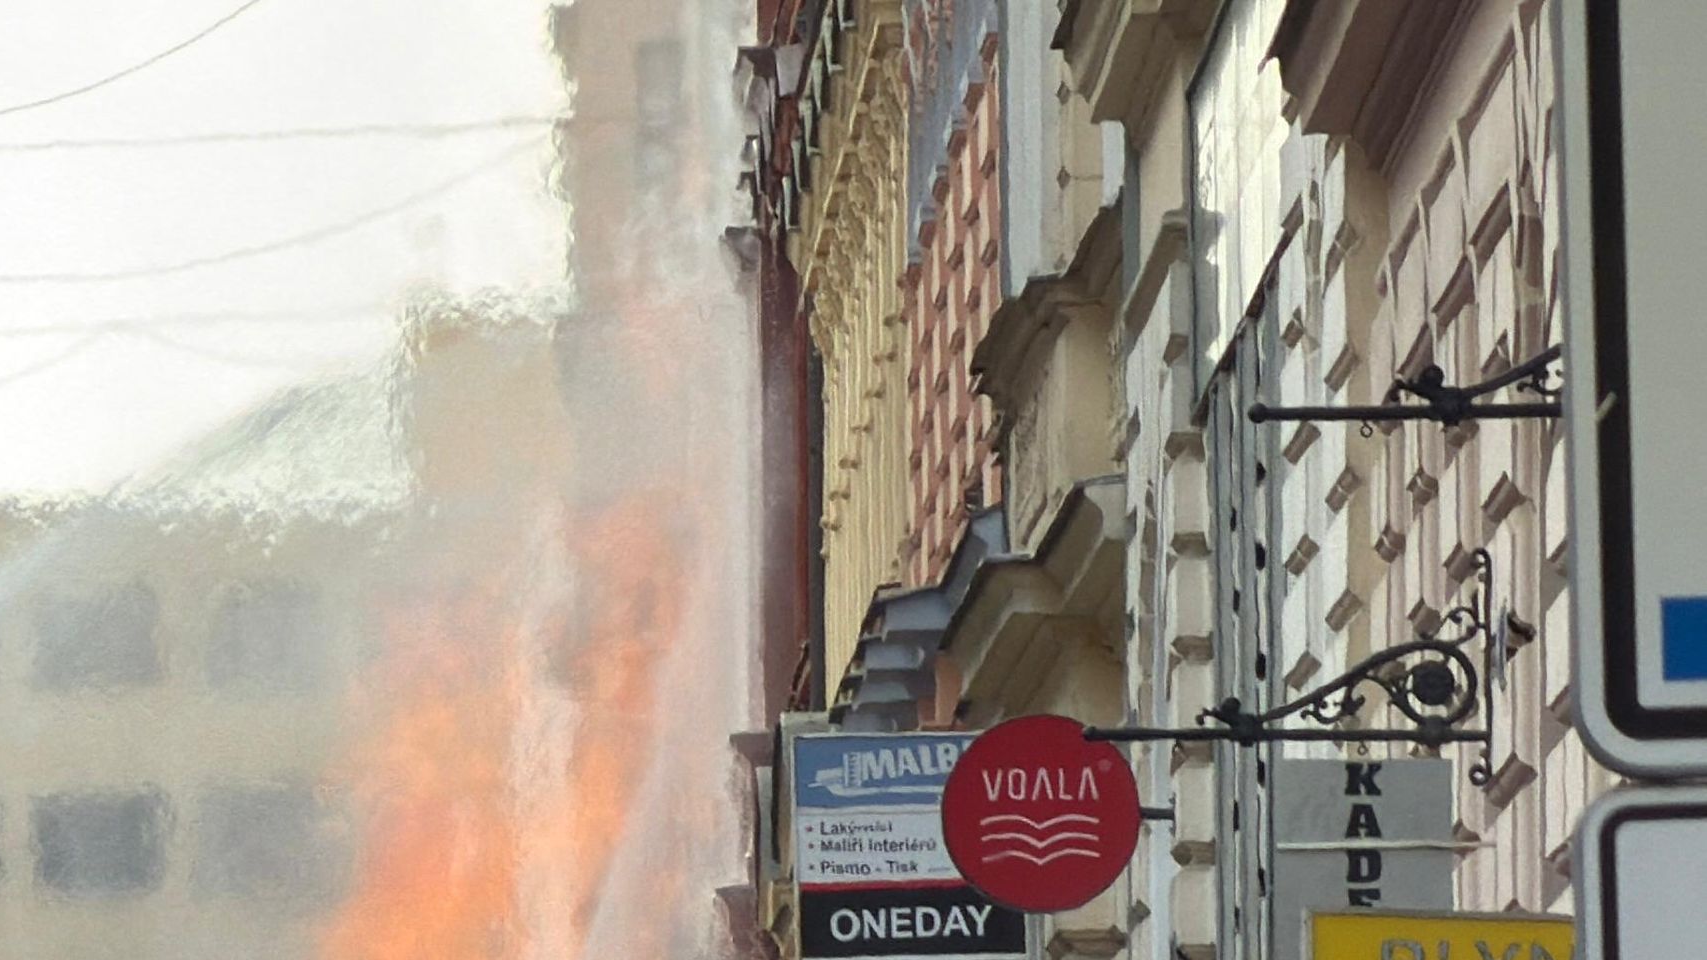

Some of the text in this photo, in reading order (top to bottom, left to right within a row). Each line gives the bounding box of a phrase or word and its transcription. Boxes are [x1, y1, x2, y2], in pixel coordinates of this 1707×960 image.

[862, 740, 973, 780] MALB
[981, 766, 1100, 801] VOALA
[830, 905, 992, 942] ONEDAY
